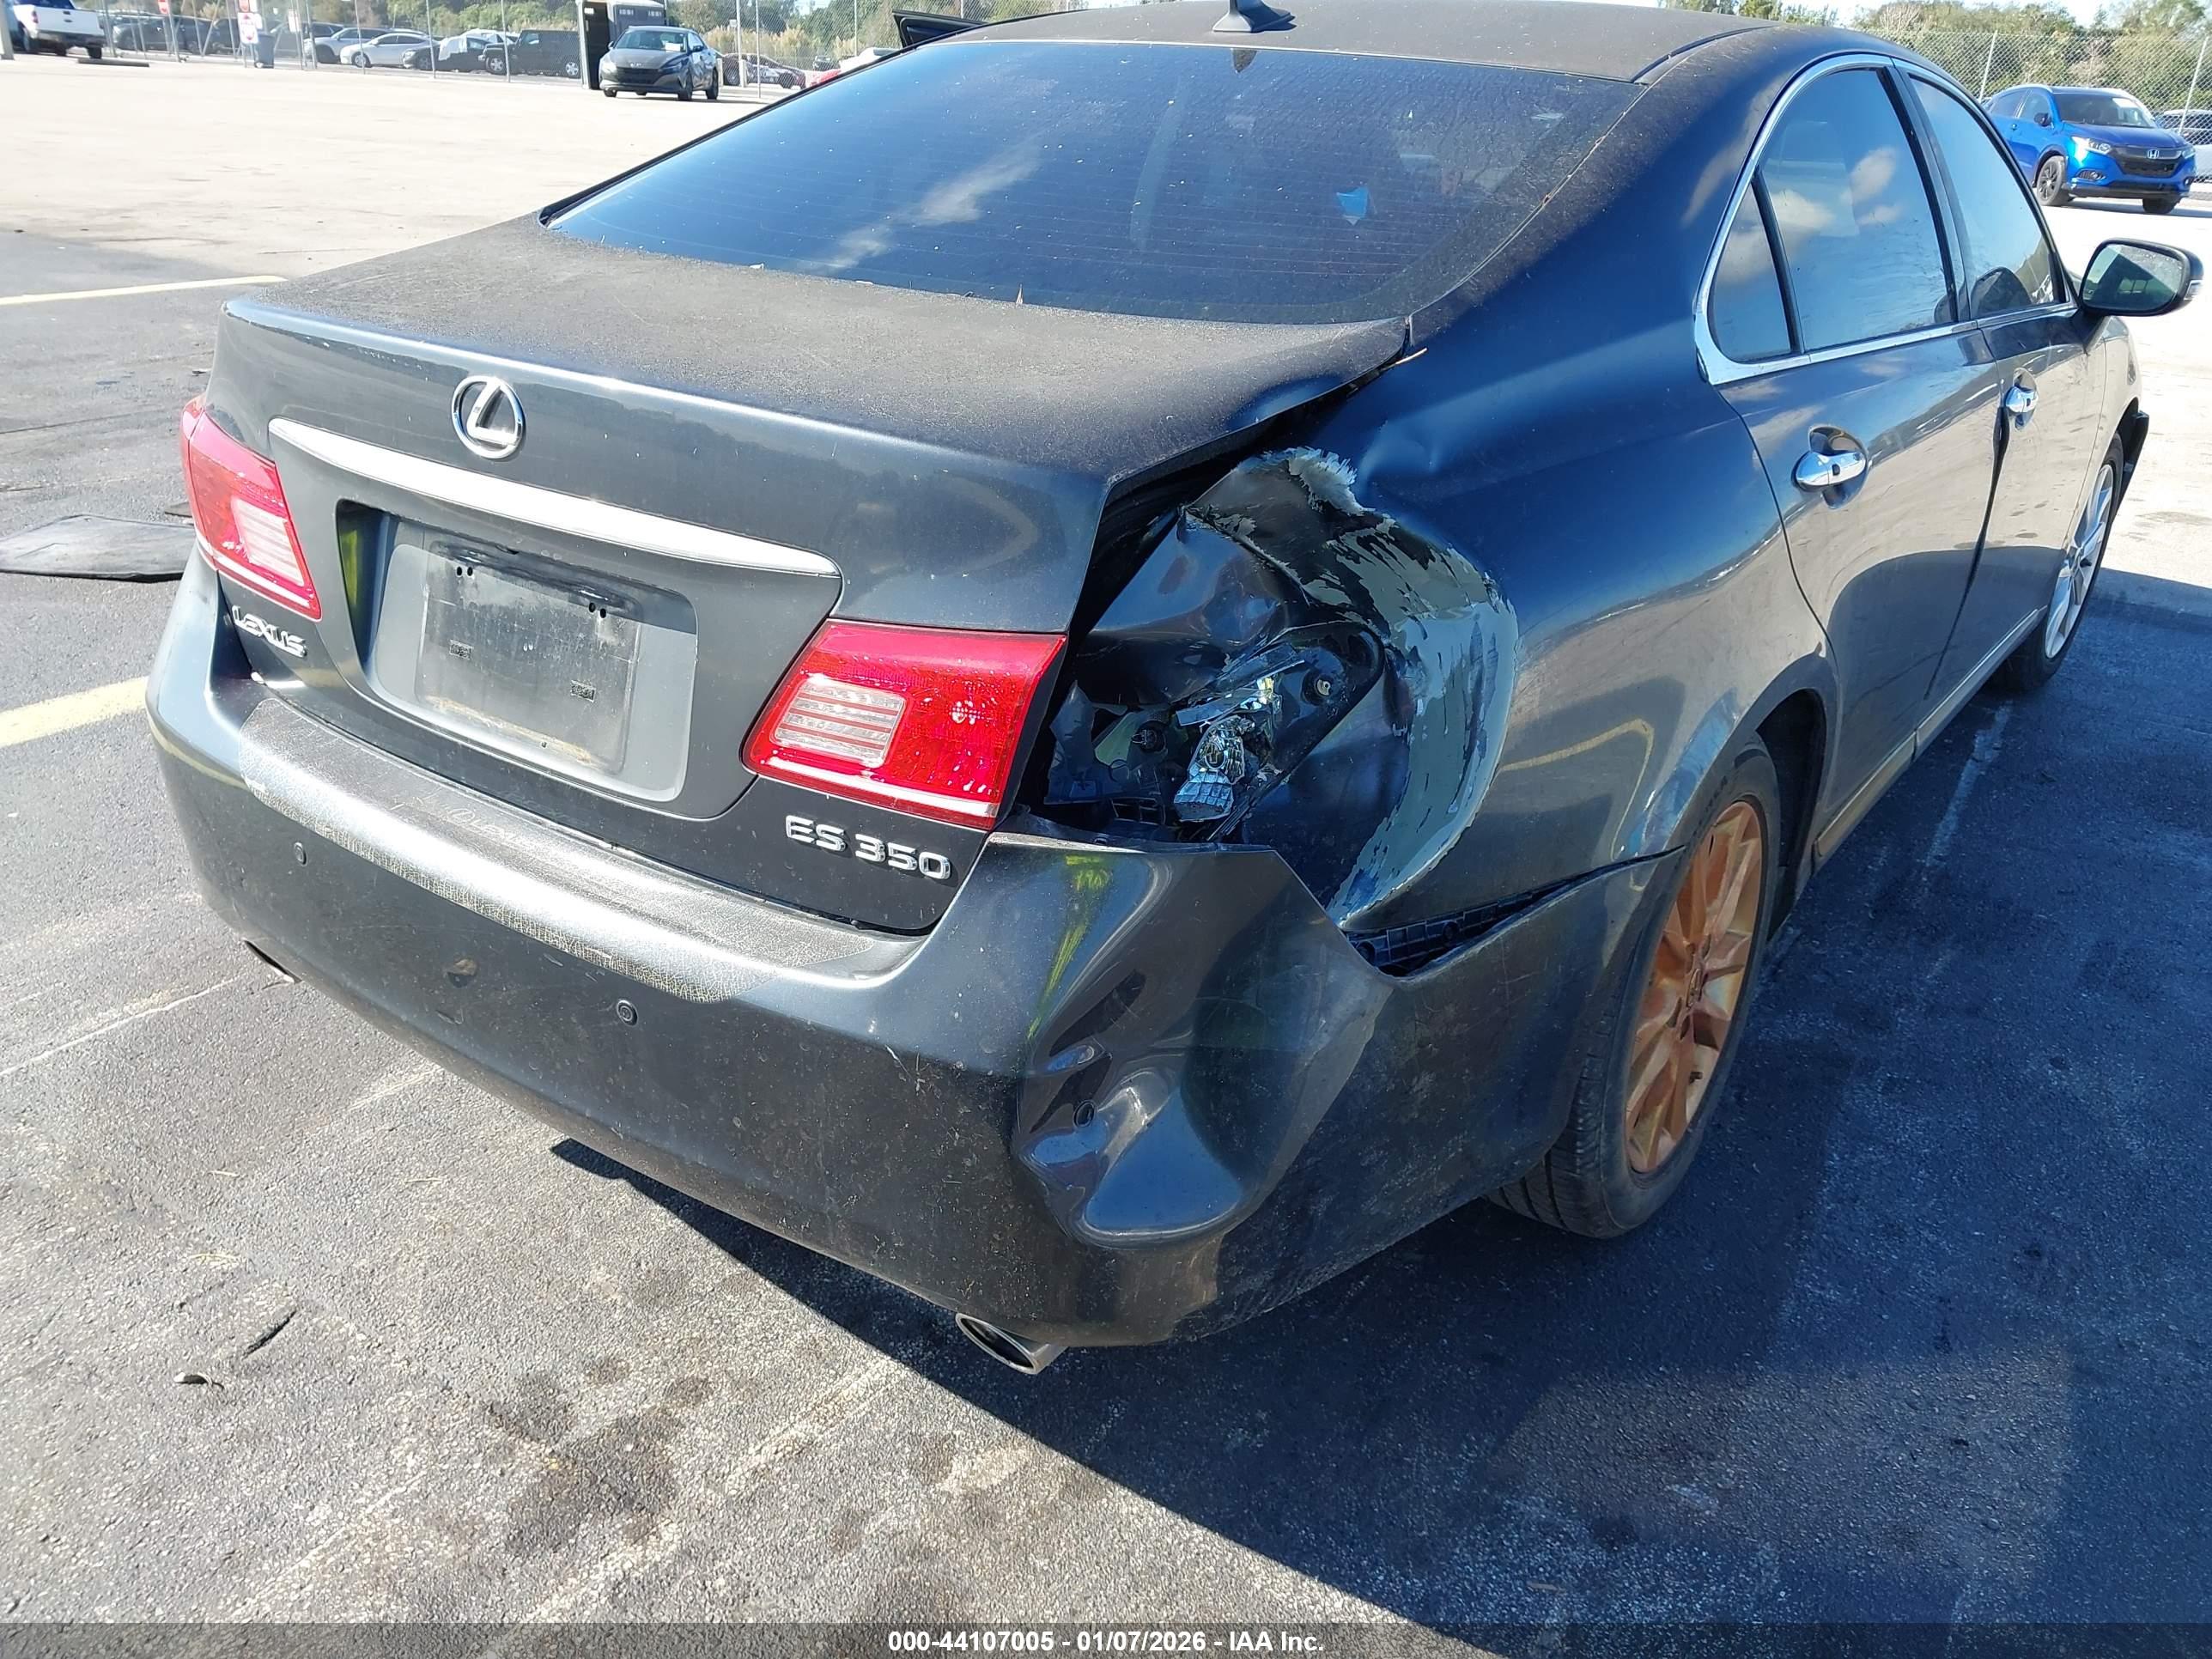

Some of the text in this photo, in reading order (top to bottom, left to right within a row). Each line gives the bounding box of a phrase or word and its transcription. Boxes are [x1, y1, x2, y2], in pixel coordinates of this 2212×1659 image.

[231, 605, 307, 658] LEXUS
[786, 815, 951, 879] ES 350
